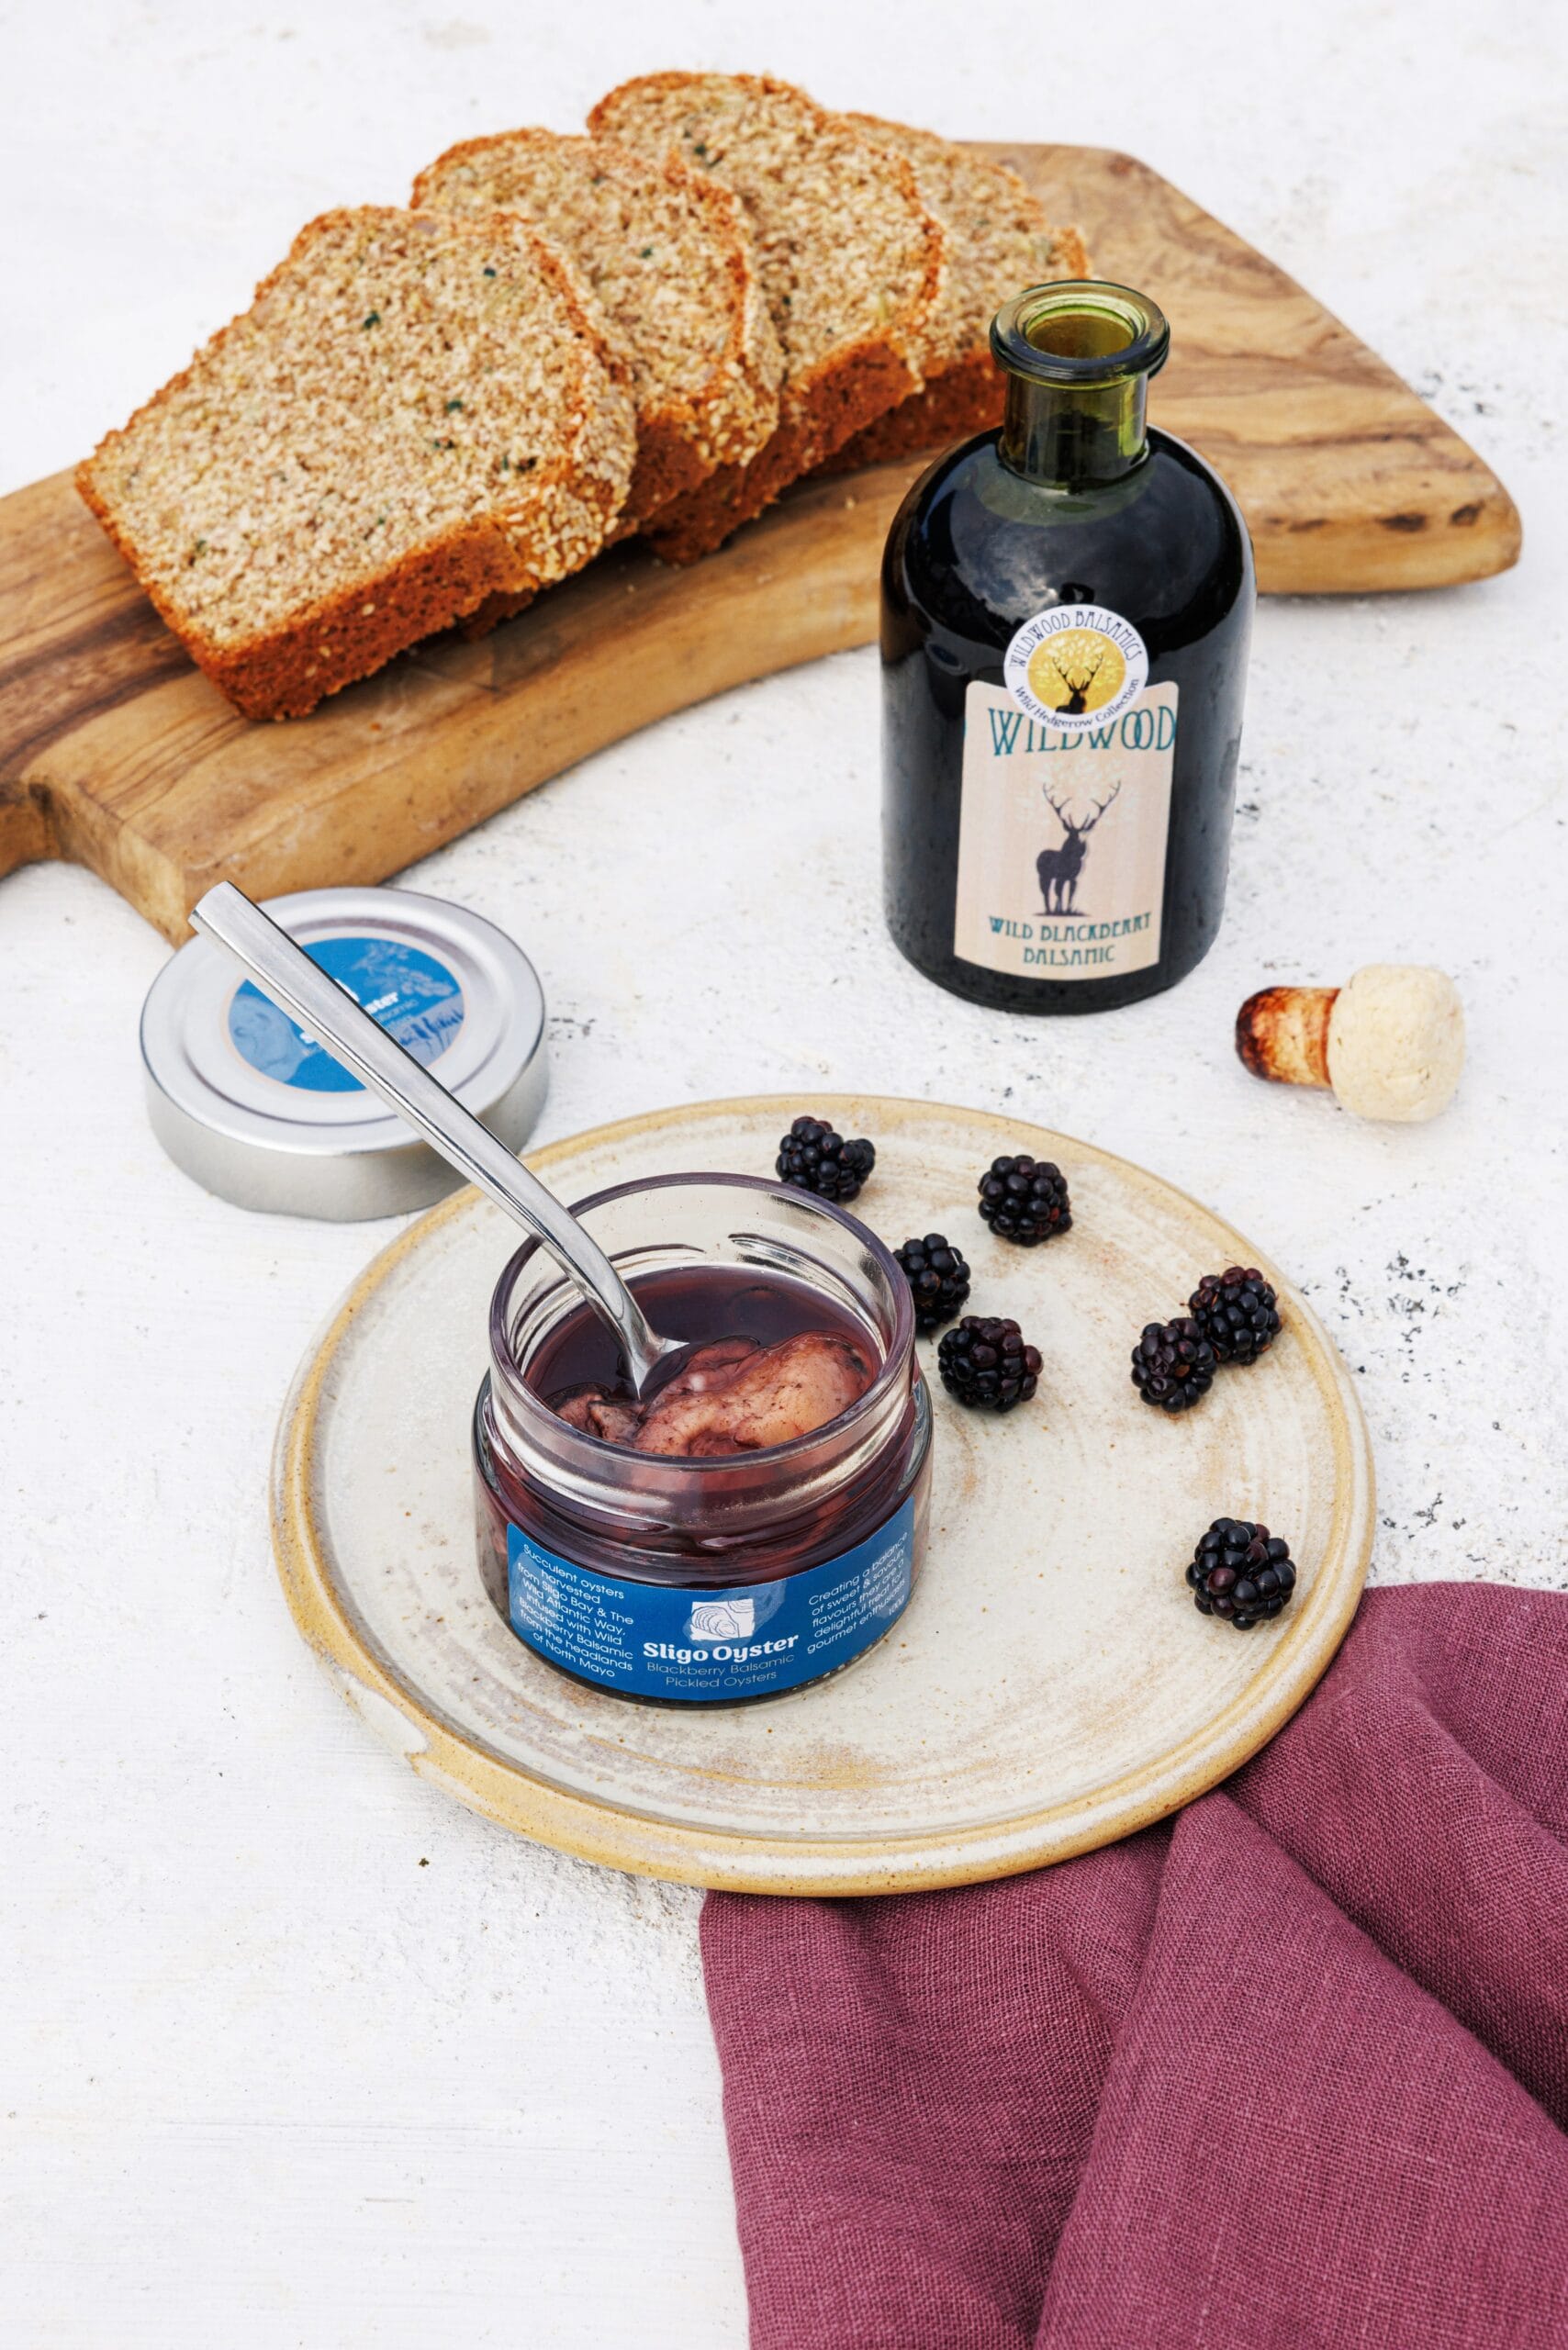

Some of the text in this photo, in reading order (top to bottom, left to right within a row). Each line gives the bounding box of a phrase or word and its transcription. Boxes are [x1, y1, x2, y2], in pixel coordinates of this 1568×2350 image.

[1009, 610, 1143, 668] WILDWOOD BALSAMICS
[1014, 677, 1140, 729] Wild Hedgerow Collection
[989, 912, 1152, 942] WILD BLACKBERRY
[1023, 945, 1115, 966] BALSAMIC
[523, 1543, 625, 1600] Succulent oysters
[541, 1569, 600, 1605] harvested
[808, 1574, 860, 1606] Creating
[862, 1568, 870, 1578] a
[872, 1531, 908, 1571] balance
[517, 1562, 633, 1625] from Sligo Bay & The
[522, 1578, 544, 1599] Wild
[546, 1595, 591, 1624] Atlantic
[812, 1604, 823, 1617] of
[826, 1585, 861, 1610] sweet
[863, 1578, 871, 1589] &
[812, 1600, 857, 1628] flavours
[859, 1583, 880, 1605] they
[881, 1567, 897, 1584] are
[813, 1602, 867, 1639] delightful
[868, 1583, 890, 1608] treat
[519, 1596, 634, 1660] Blackberry Balsamic
[521, 1609, 633, 1672] from the headlands
[566, 1617, 591, 1636] with
[594, 1629, 622, 1646] Wild
[643, 1634, 800, 1665] Sligo Oyster
[807, 1621, 857, 1654] gourmet
[532, 1631, 616, 1678] of North Mayo
[646, 1653, 795, 1677] Blackberry Balsamic
[666, 1671, 778, 1688] Pickled Oysters
